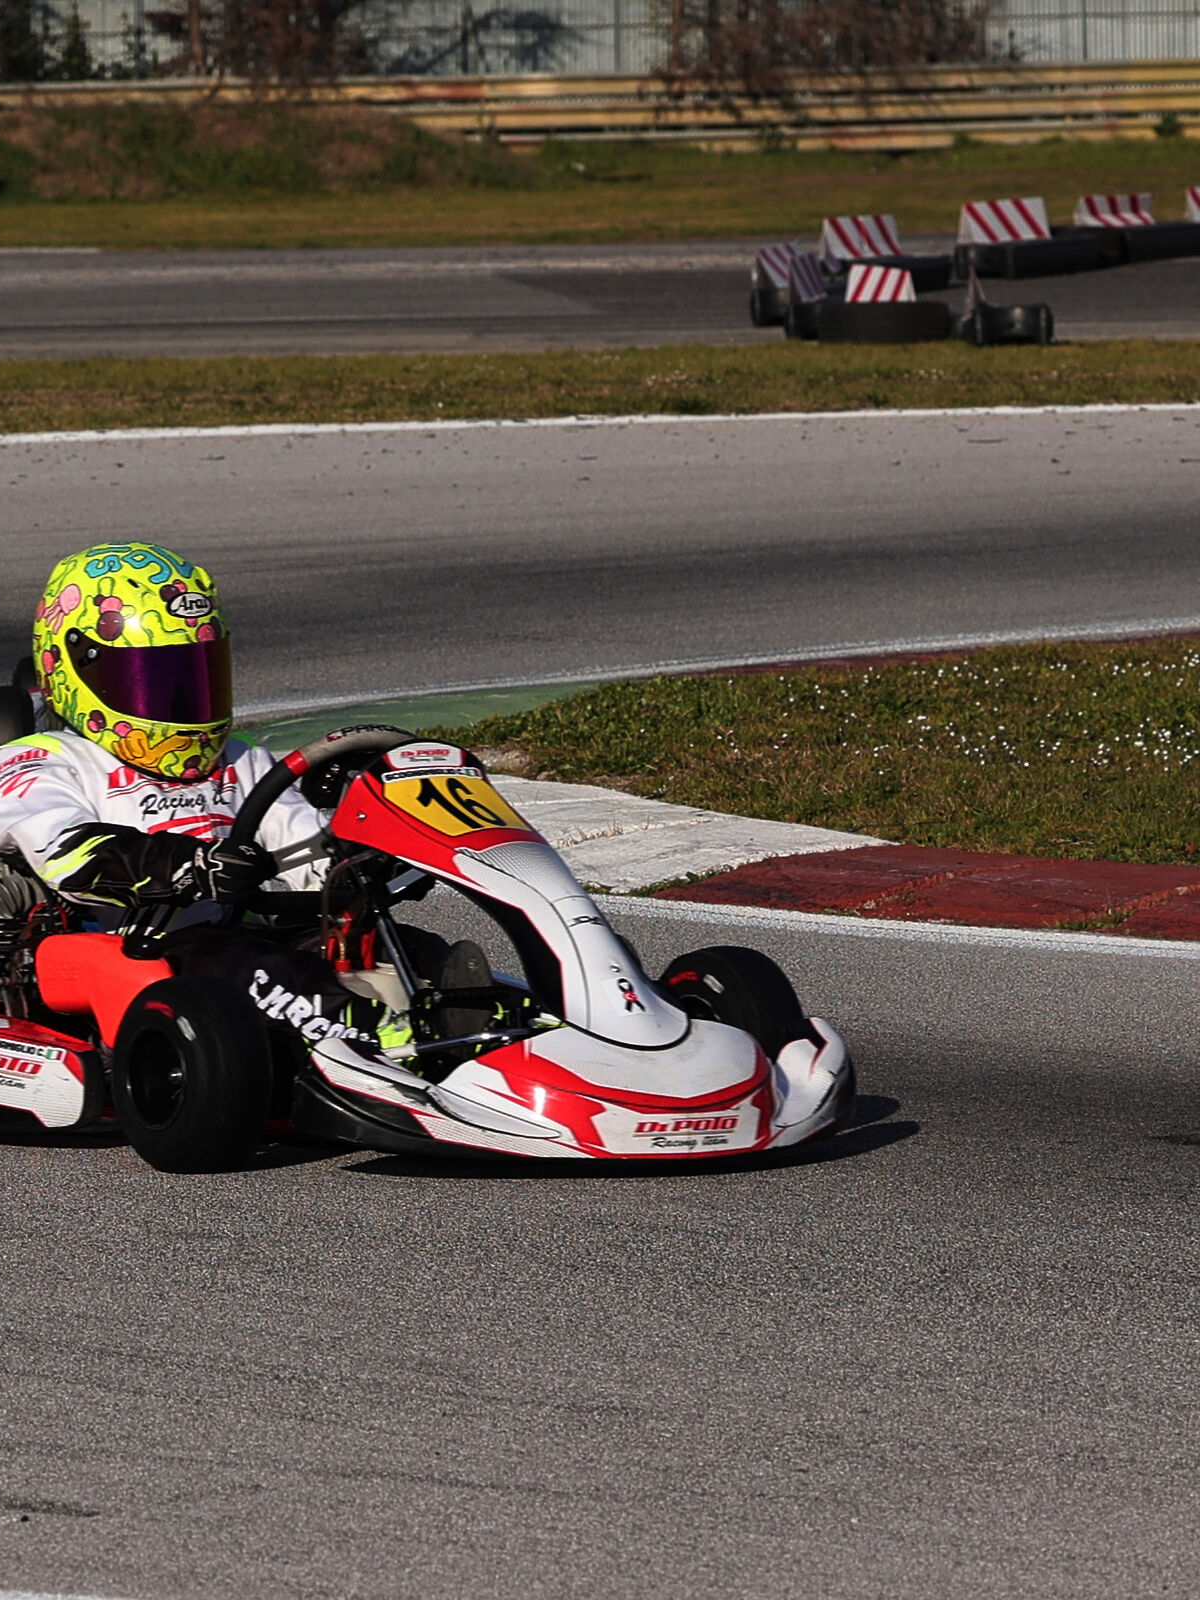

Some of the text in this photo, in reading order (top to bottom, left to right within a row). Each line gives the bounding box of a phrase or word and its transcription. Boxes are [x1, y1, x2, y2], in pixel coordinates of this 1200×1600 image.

[173, 596, 209, 613] Arai
[139, 793, 206, 820] Racing
[416, 778, 506, 829] 16
[651, 1136, 698, 1150] Racing
